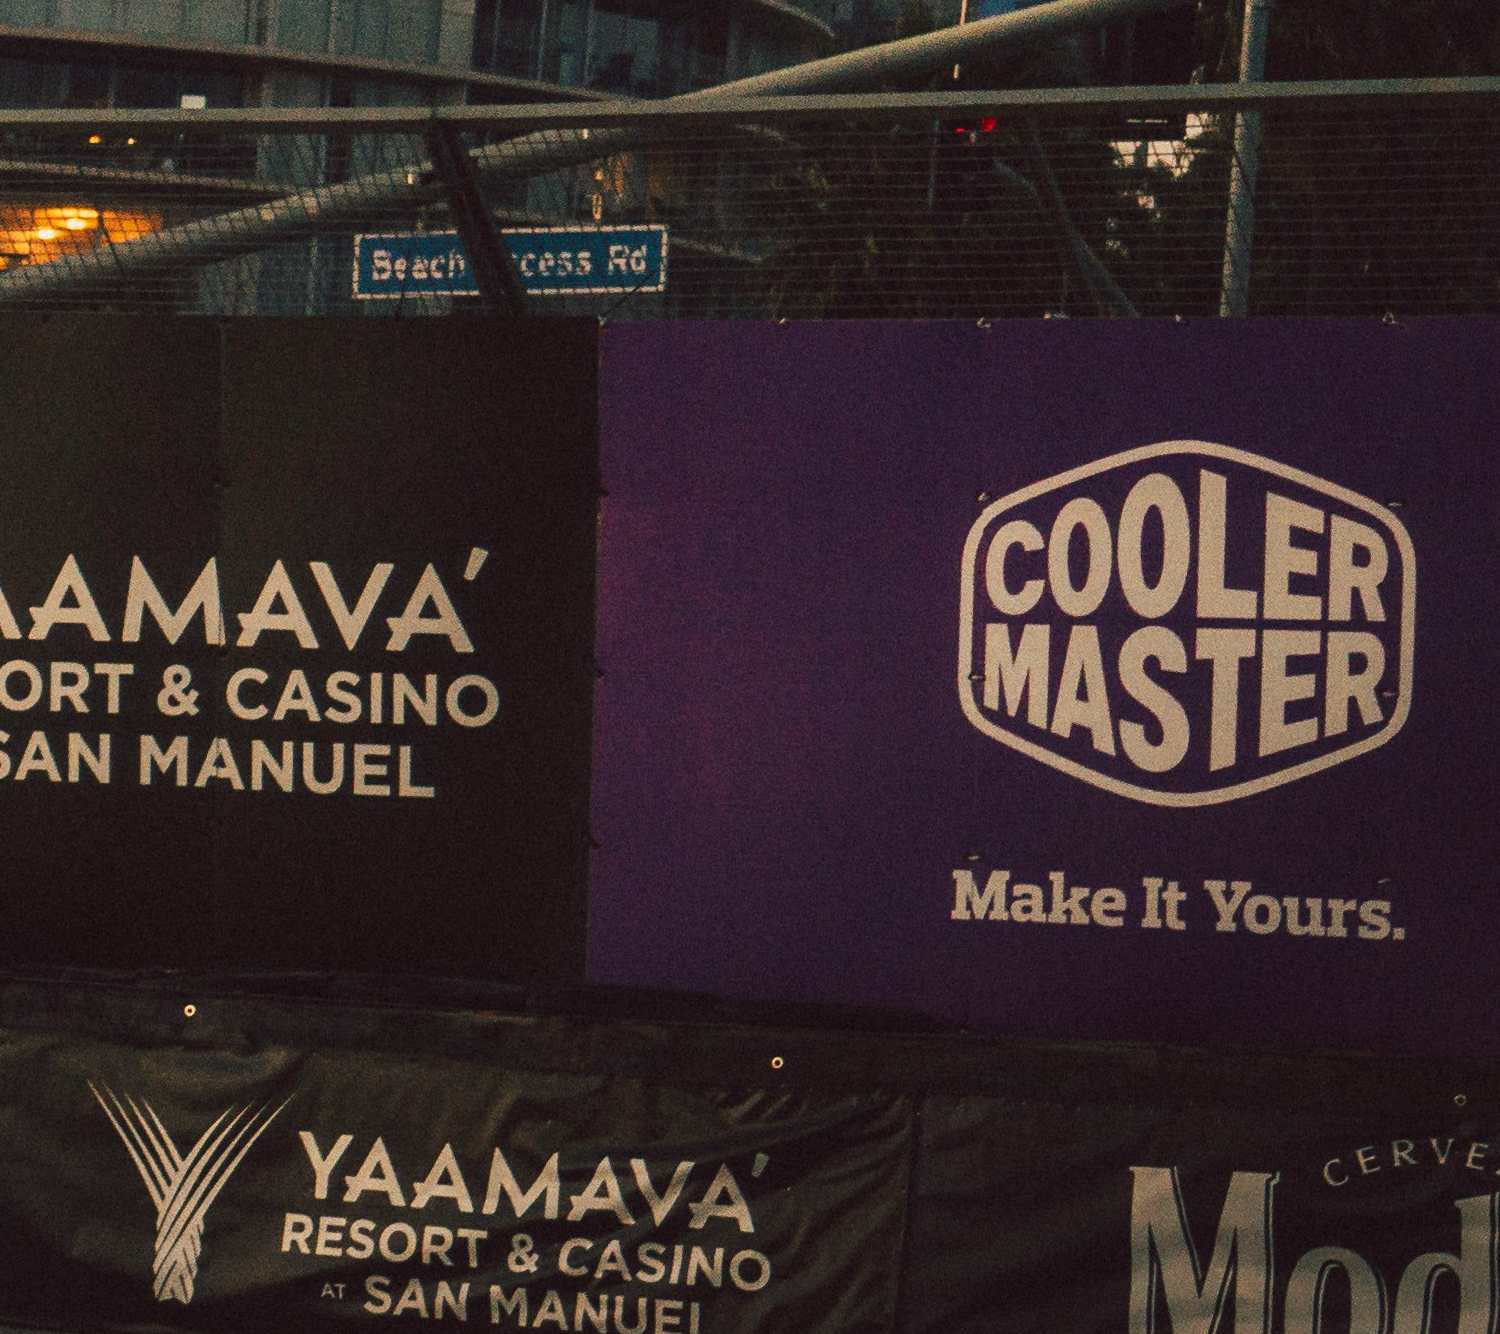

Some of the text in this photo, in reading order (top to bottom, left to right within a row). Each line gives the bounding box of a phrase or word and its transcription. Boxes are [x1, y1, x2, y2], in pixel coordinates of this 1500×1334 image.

[372, 244, 647, 281] Beach cess Rd
[984, 469, 1389, 622] COOLER
[156, 666, 200, 716] &
[226, 667, 499, 728] CASINO
[983, 622, 1387, 774] MASTER
[140, 734, 434, 798] MANUEL
[951, 870, 1405, 941] Make It Yours.
[1323, 1137, 1500, 1186] CERVE
[281, 1213, 771, 1291] RESORT & CASINO
[321, 1282, 347, 1300] AT
[363, 1276, 469, 1322] SAN
